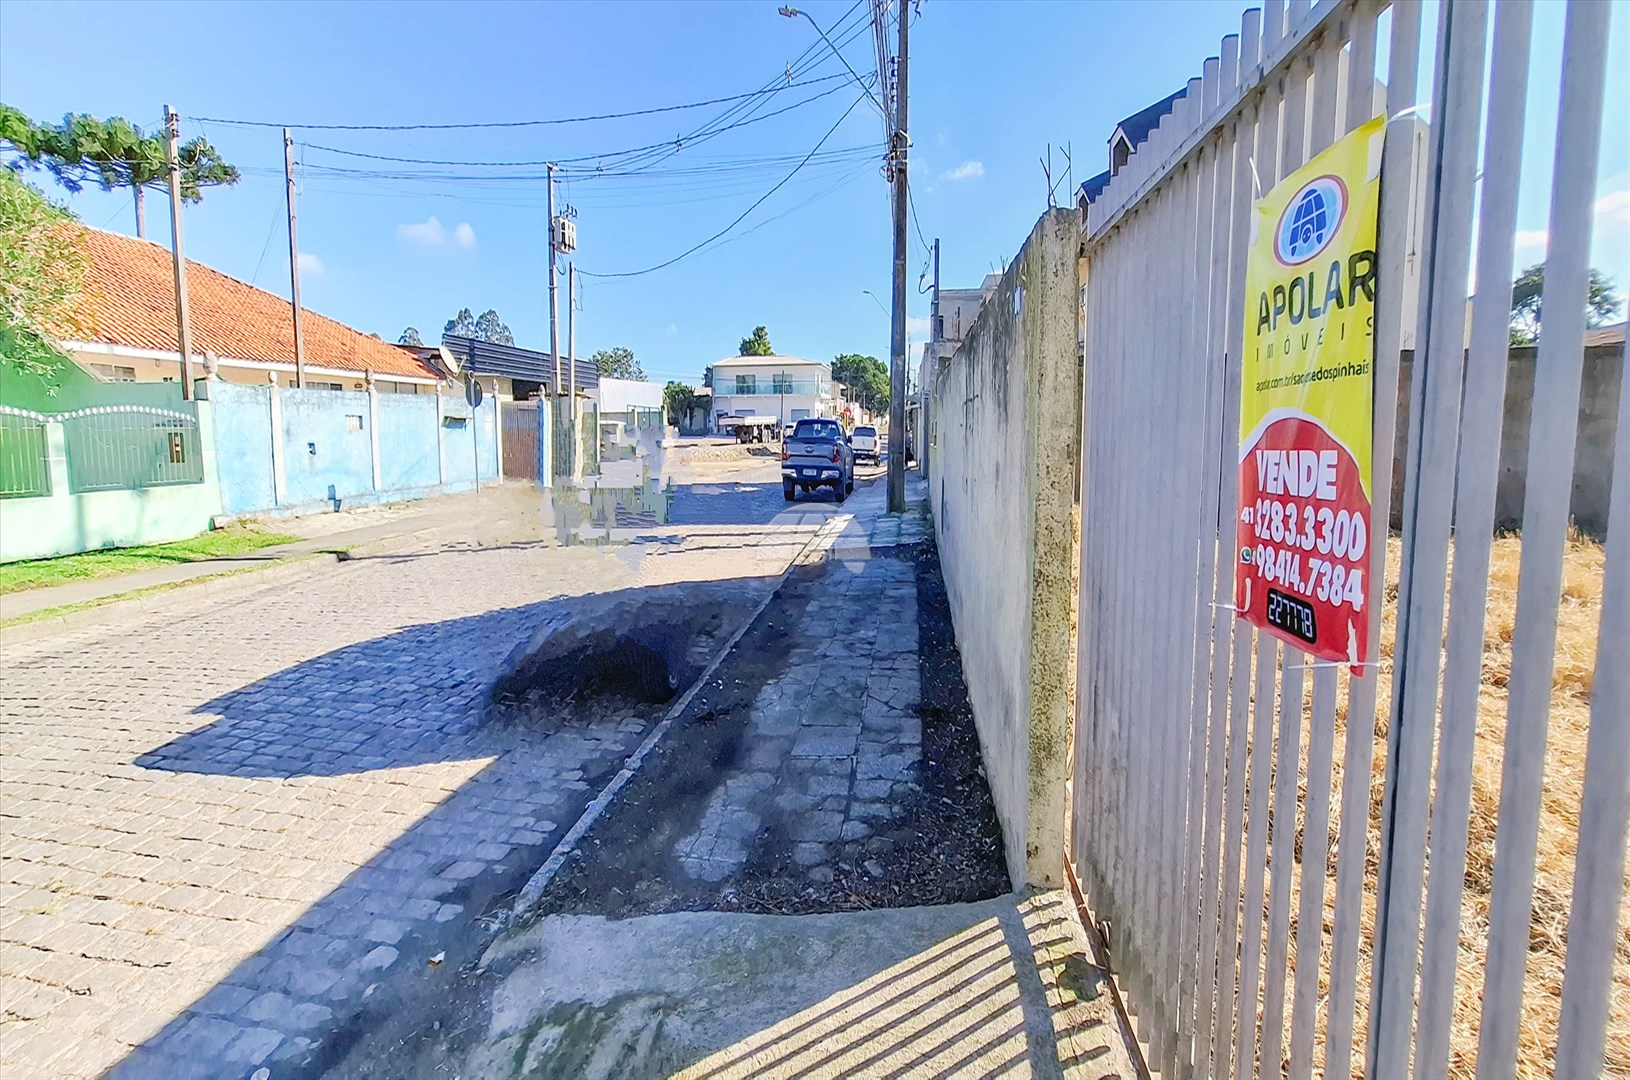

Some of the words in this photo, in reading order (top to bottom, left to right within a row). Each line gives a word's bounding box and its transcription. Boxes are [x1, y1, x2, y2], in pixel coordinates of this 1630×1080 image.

[1257, 250, 1376, 336] APOLAR
[1256, 316, 1373, 362] IMÓVEIS
[1256, 450, 1338, 500] VENDE
[1240, 506, 1254, 524] 41
[1255, 497, 1367, 562] 3283.3300
[1256, 543, 1364, 612] 98414.7384
[1268, 593, 1313, 639] 227778
